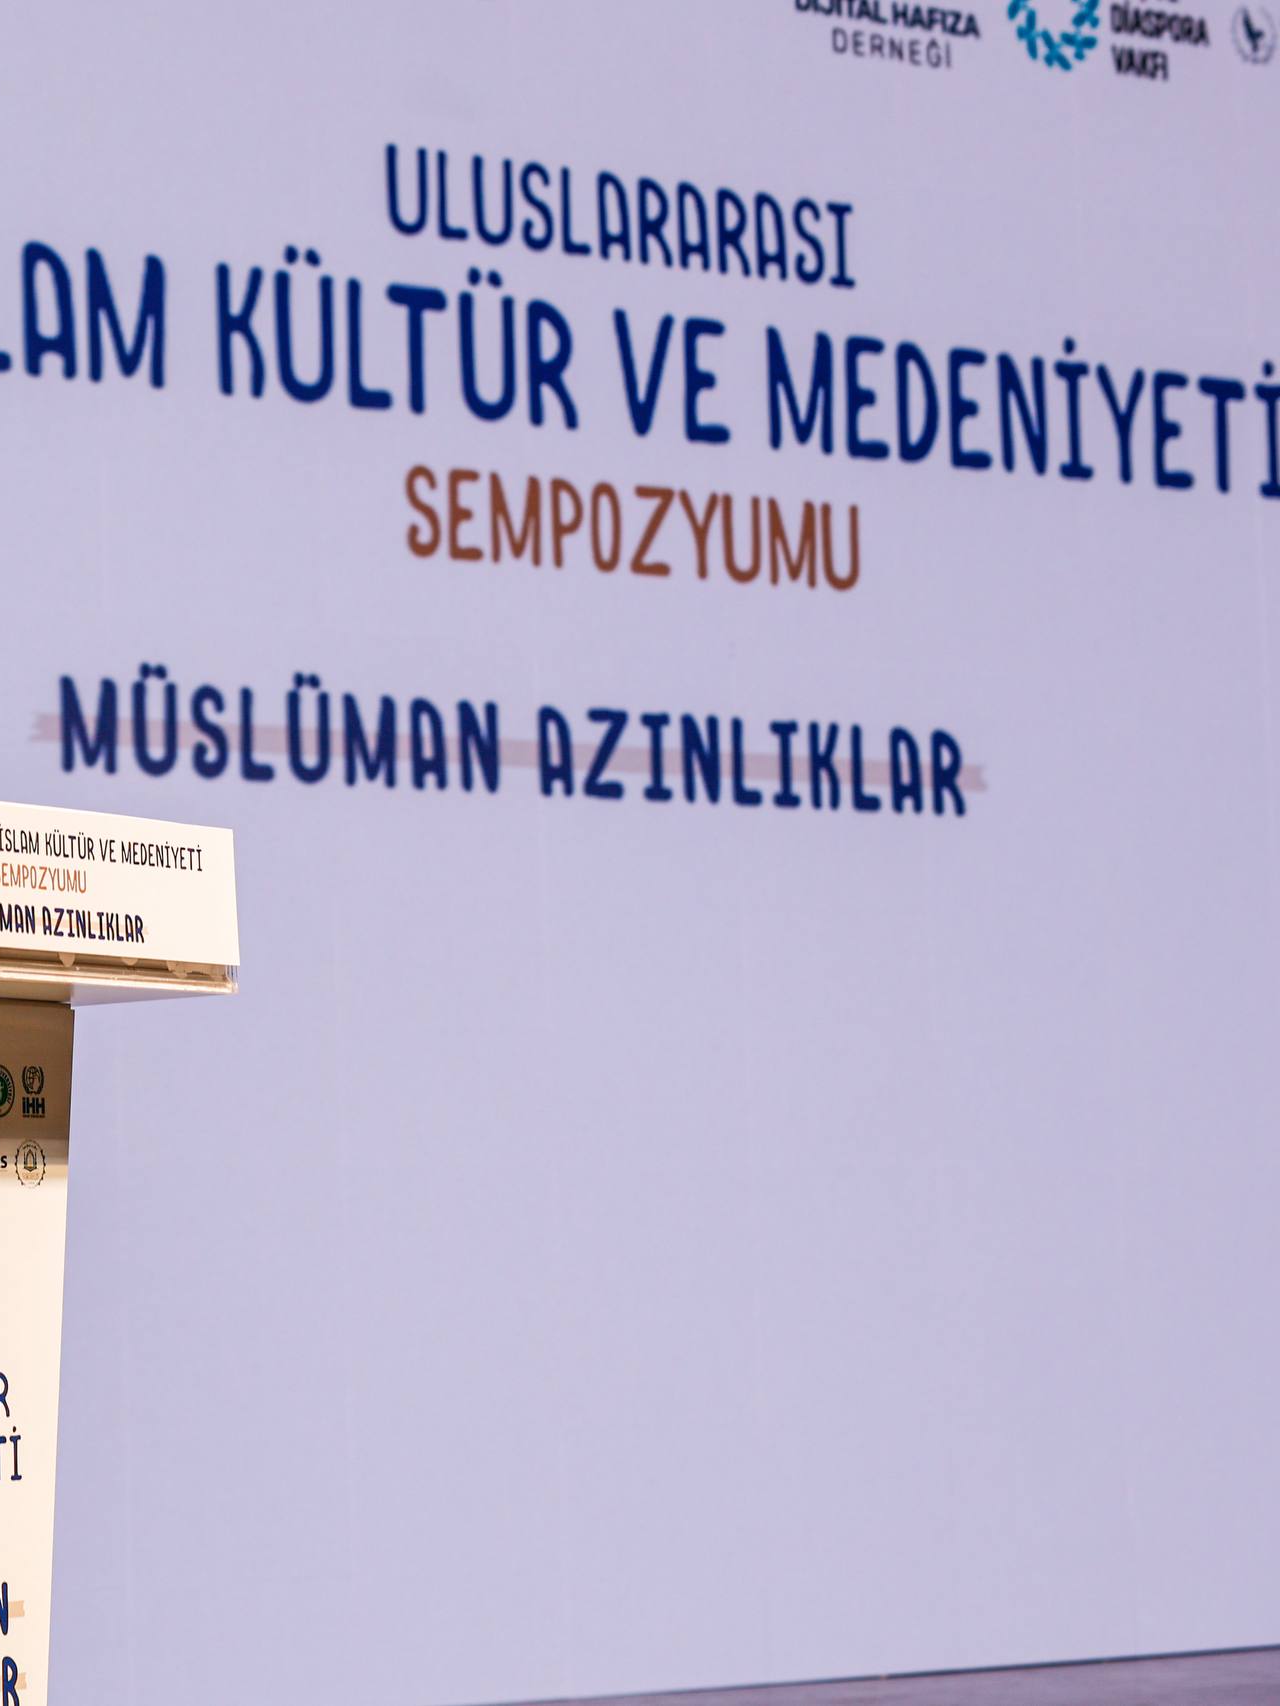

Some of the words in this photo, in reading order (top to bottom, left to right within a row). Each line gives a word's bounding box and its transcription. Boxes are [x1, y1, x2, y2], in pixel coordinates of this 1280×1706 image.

[386, 143, 855, 288] ULUSLARARASI
[217, 245, 578, 430] KÜLTÜR
[614, 308, 730, 444] VE
[766, 326, 1280, 499] MEDENİYETİ
[406, 465, 860, 591] SEMPOZYUMU
[59, 663, 499, 793] MÜSLÜMAN
[540, 706, 967, 817] AZINLIKLAR
[45, 829, 95, 861] KÜLTÜR
[99, 839, 117, 863] VE
[121, 841, 203, 872] MEDENİYETİ
[43, 906, 145, 943] AZINLIKLAR
